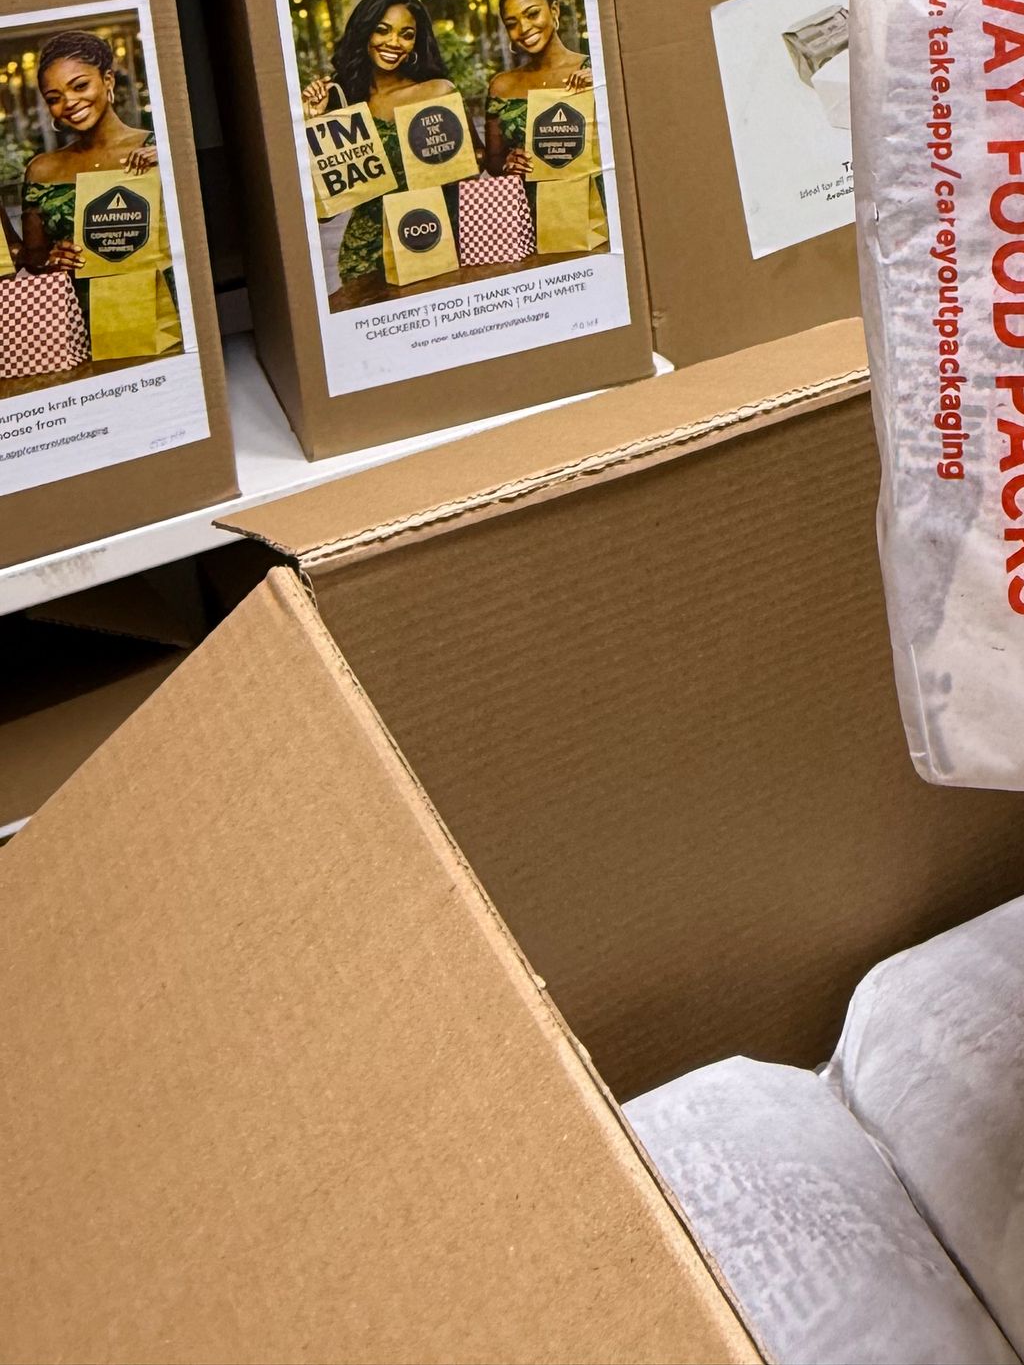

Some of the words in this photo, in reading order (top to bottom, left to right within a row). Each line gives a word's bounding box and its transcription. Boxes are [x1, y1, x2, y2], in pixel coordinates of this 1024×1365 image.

[305, 112, 372, 158] I'M
[316, 142, 376, 172] DELIVERY
[321, 155, 386, 197] BAG
[92, 212, 142, 223] WARNING
[404, 222, 437, 238] FOOD
[926, 26, 970, 480] take.app/careyoutpackaging
[366, 318, 430, 340] CHECKERED
[441, 308, 471, 324] PLAIN
[473, 299, 514, 316] BROWN
[523, 290, 552, 304] PLAIN
[554, 282, 586, 296] WHITE
[372, 306, 420, 326] DELIVERY
[431, 298, 464, 312] FOOD
[474, 287, 511, 304] THANK
[512, 282, 536, 294] YOU
[544, 268, 594, 286] WARNING
[0, 406, 44, 424] urpose
[48, 396, 77, 413] kraft
[80, 382, 139, 406] packaging
[141, 374, 166, 388] bags
[0, 426, 32, 440] oose
[36, 416, 67, 431] from
